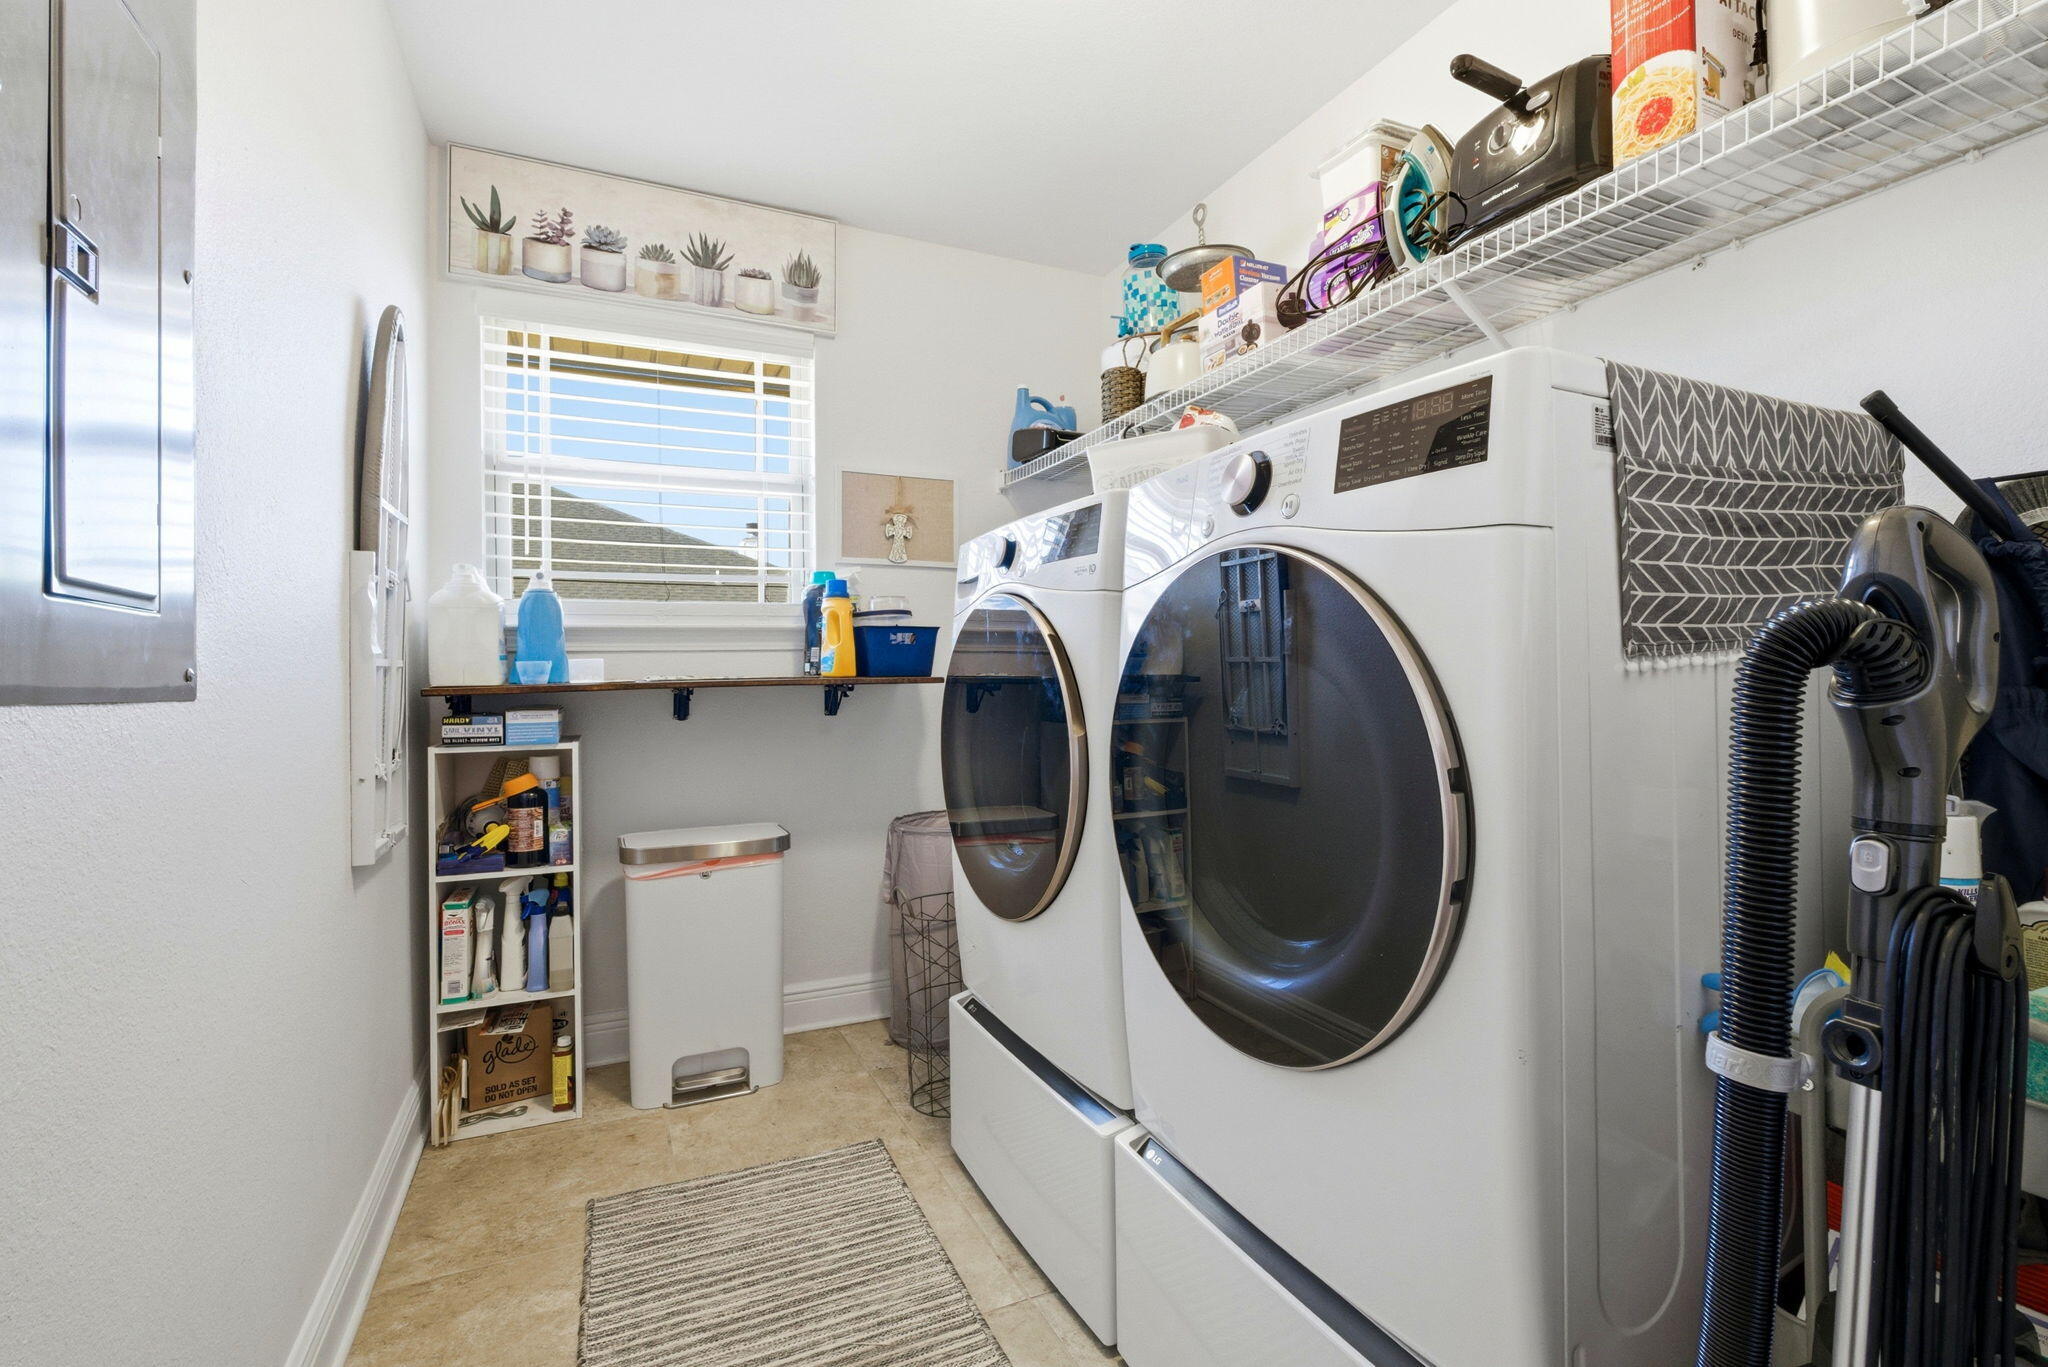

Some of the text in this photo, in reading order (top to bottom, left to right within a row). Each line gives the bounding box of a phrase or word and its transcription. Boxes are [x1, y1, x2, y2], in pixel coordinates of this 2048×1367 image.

[1719, 0, 1757, 21] ATTAC
[463, 726, 500, 734] VINYL
[1958, 888, 1978, 896] KILLS
[482, 1035, 537, 1074] glade
[485, 1076, 537, 1095] SOLD AS SET
[485, 1084, 538, 1103] DO NOT OPEN
[1152, 1154, 1162, 1165] LG
